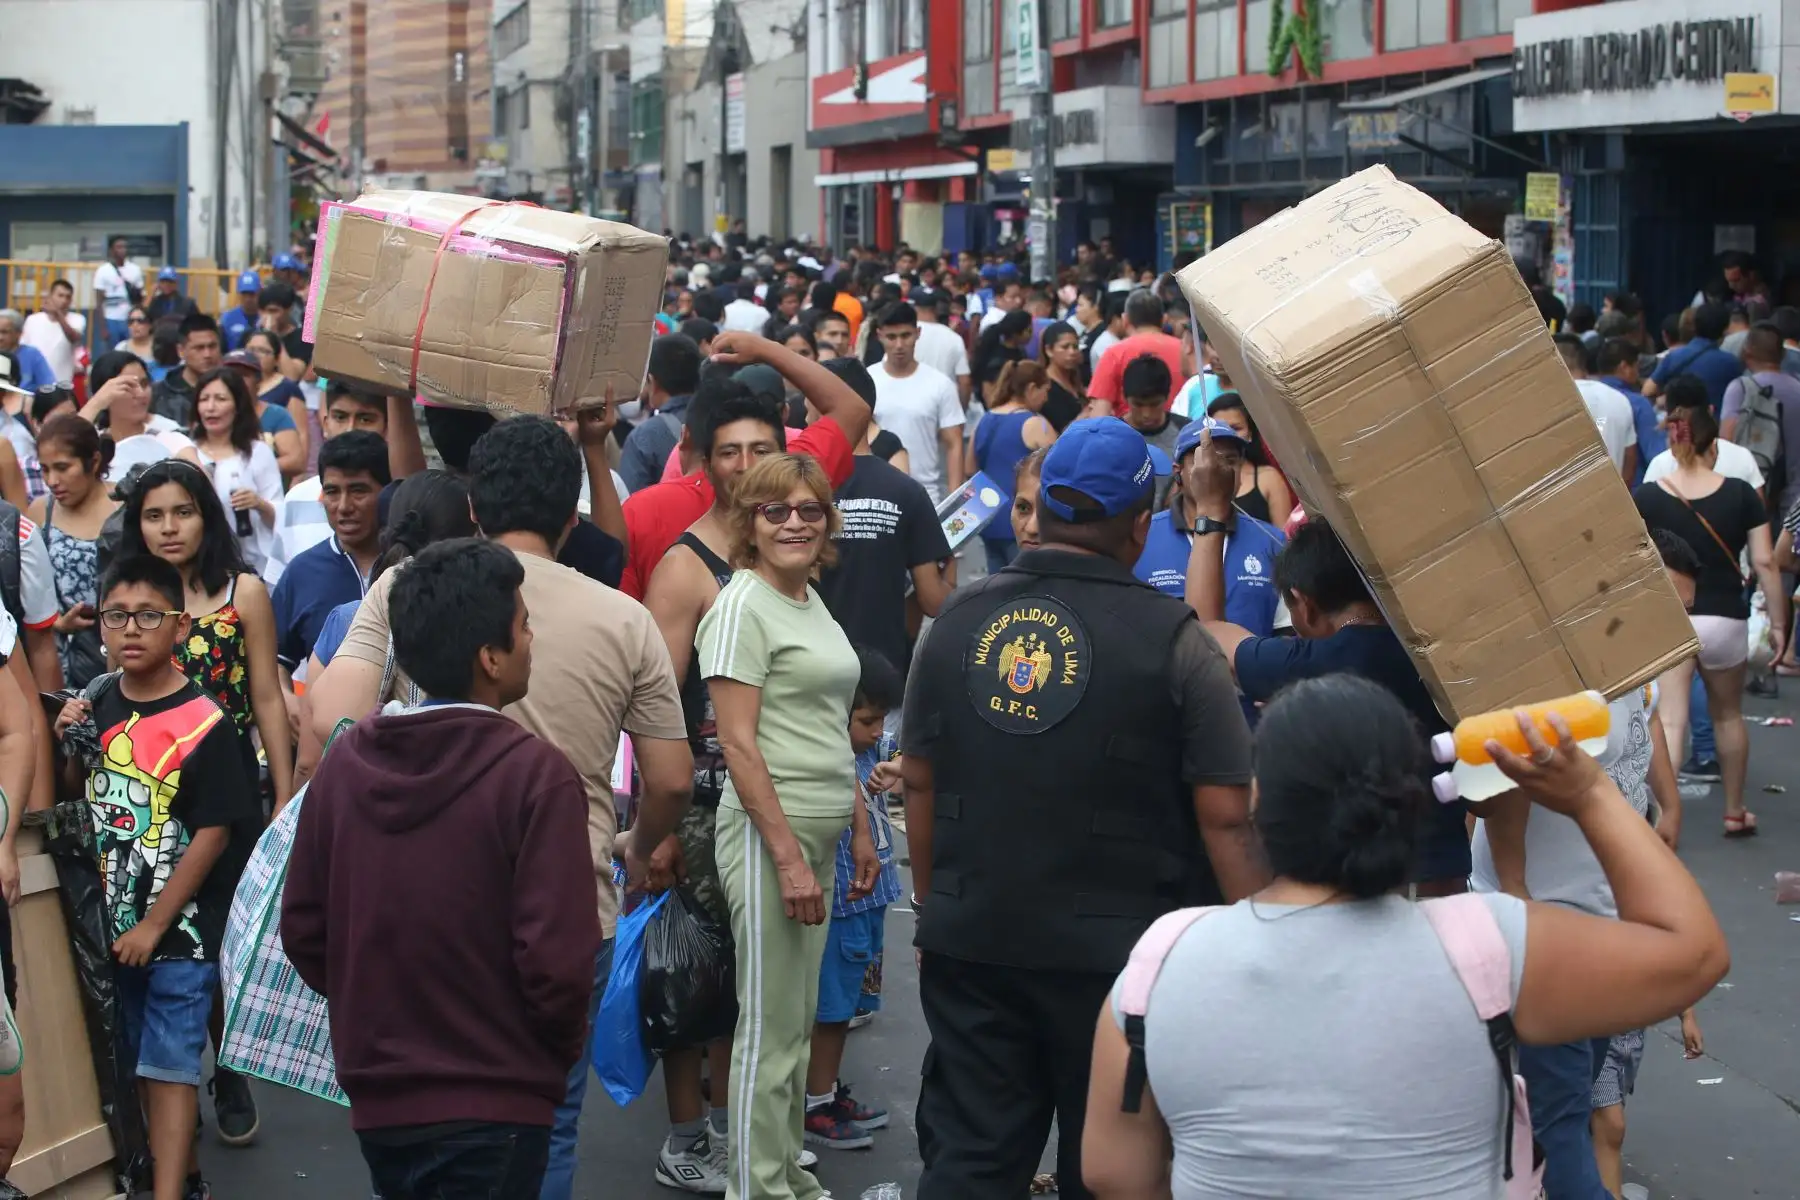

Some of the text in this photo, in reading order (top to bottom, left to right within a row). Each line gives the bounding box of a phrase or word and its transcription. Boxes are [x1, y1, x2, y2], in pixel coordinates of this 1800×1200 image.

[975, 607, 1058, 665] MUNICIPALIDAD
[1056, 625, 1074, 647] DE
[1061, 651, 1078, 684] LIMA
